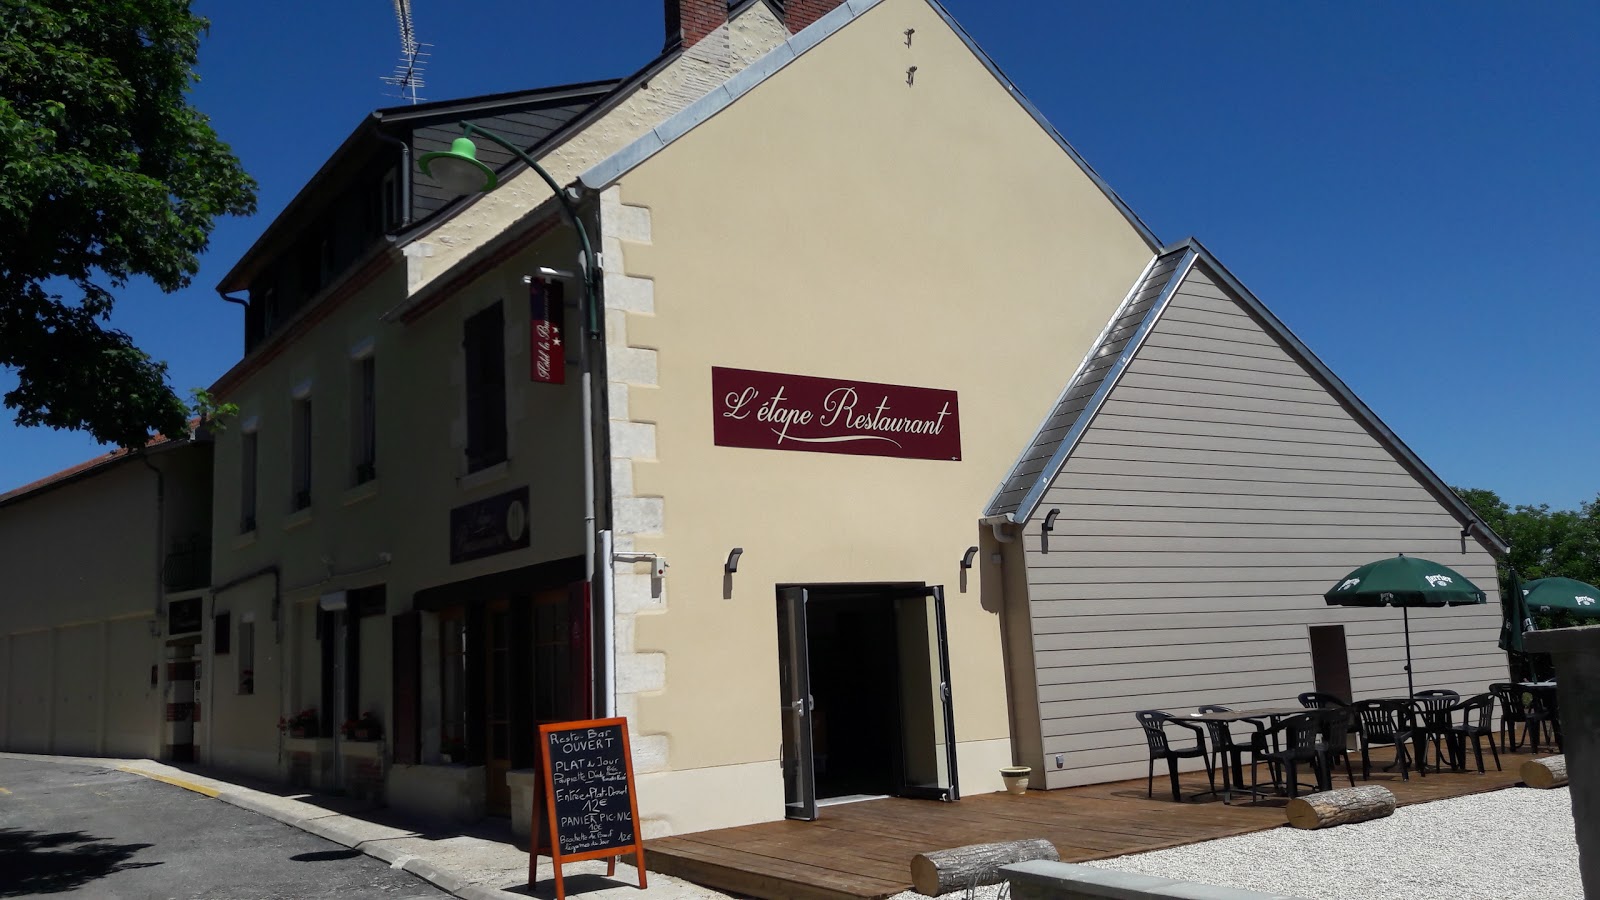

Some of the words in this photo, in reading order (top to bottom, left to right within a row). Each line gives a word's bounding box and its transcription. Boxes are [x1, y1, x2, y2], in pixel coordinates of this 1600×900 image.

[723, 385, 814, 445] L'étape
[820, 386, 952, 436] Restaurant
[587, 729, 611, 739] Bar
[563, 738, 614, 753] OUVERT
[556, 759, 585, 772] PLAT
[582, 799, 607, 812] 12€
[561, 815, 597, 827] PANIER
